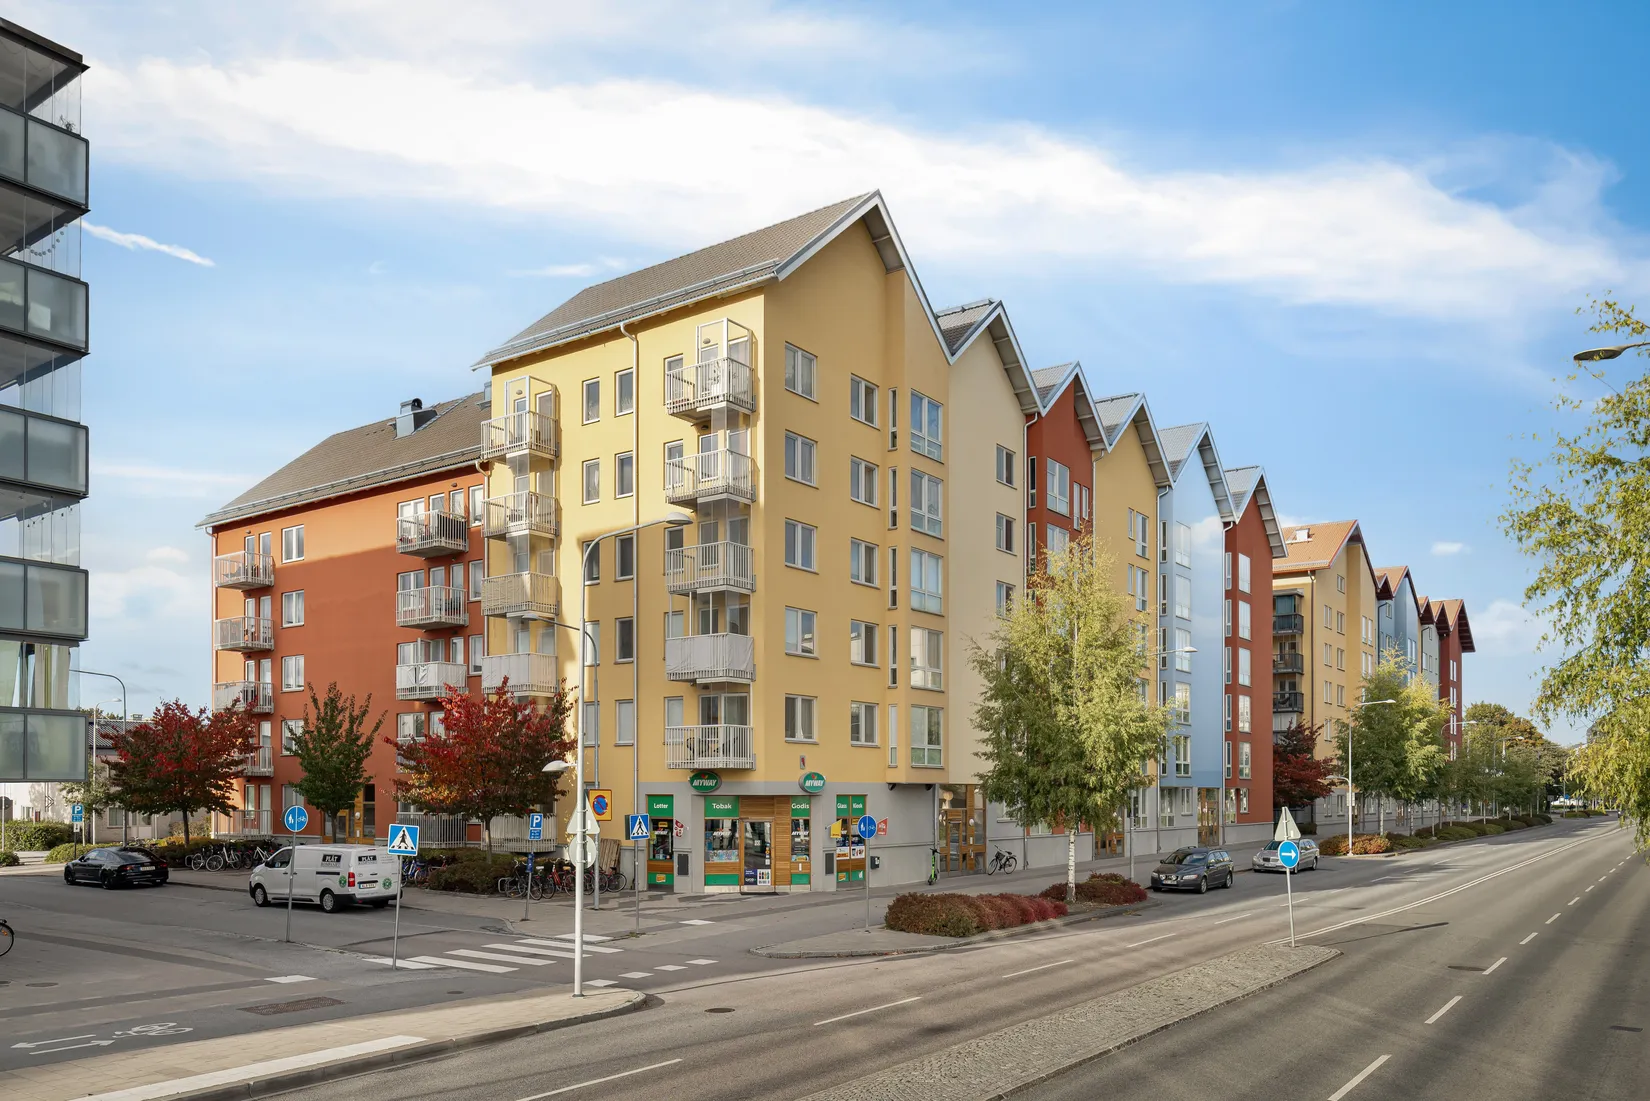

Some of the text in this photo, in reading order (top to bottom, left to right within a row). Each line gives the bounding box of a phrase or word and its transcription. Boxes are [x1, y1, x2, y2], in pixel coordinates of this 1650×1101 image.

[804, 779, 824, 787] MYWAY
[75, 805, 82, 814] P
[533, 815, 541, 827] P
